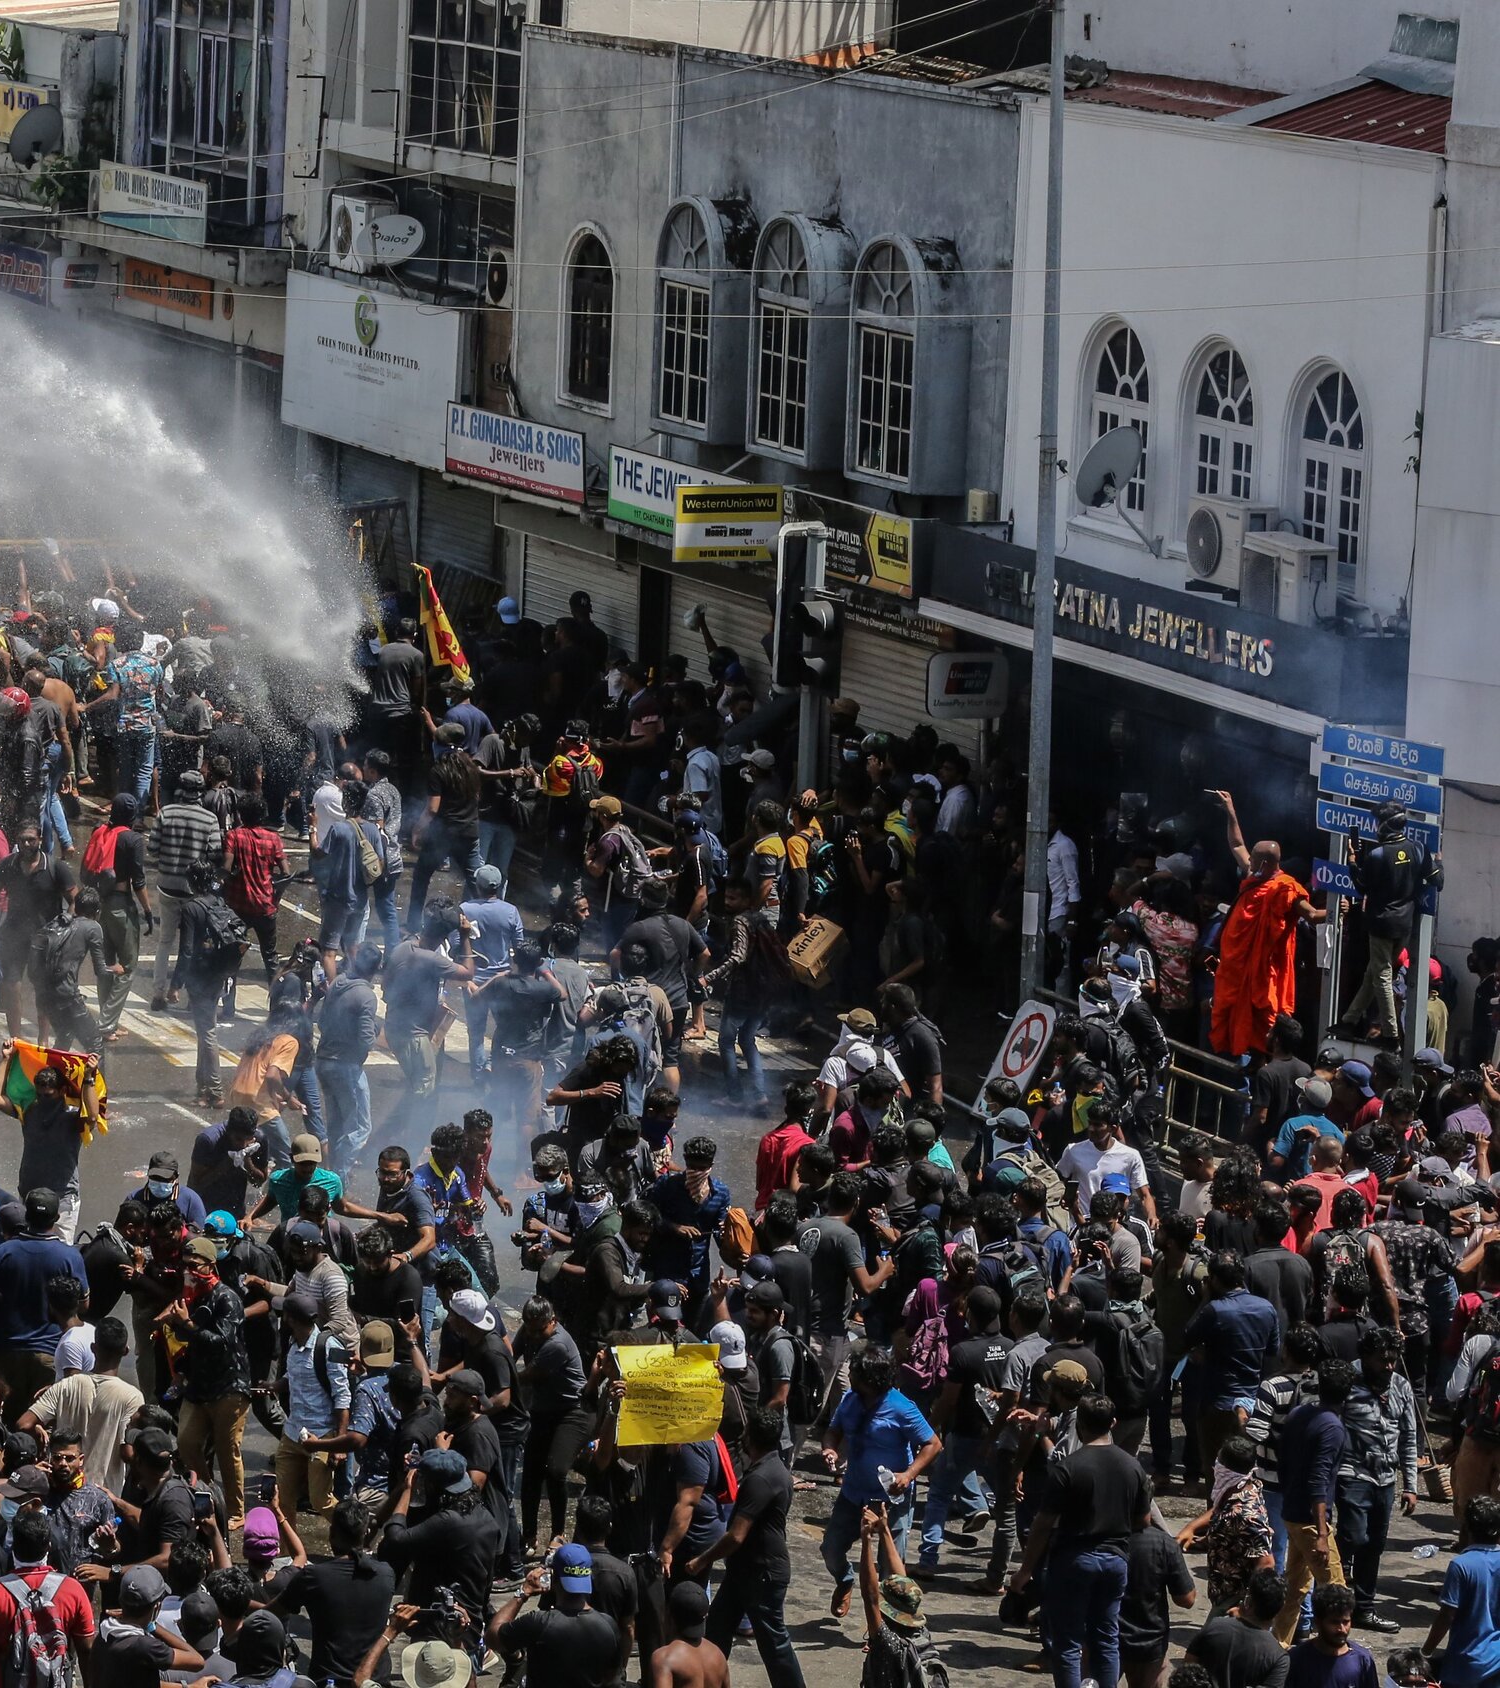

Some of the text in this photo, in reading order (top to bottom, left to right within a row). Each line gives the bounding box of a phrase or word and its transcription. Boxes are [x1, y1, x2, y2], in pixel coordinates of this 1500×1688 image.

[132, 174, 149, 197] WINGS
[373, 231, 409, 245] Dialog
[317, 335, 336, 349] GREEN
[338, 341, 357, 356] TOURS
[358, 346, 363, 356] &
[365, 347, 391, 364] RESORTS
[490, 446, 545, 473] Jewellers
[536, 431, 544, 455] &
[547, 431, 580, 466] SONS
[614, 455, 643, 493] THE
[531, 483, 559, 495] Colombo
[643, 512, 665, 527] CHATHAM
[705, 528, 727, 538] Money
[699, 550, 717, 558] ROYAL
[719, 550, 739, 558] MONEY
[885, 541, 904, 555] UNION
[1129, 603, 1275, 678] JEWELLERS
[792, 921, 825, 957] kinley
